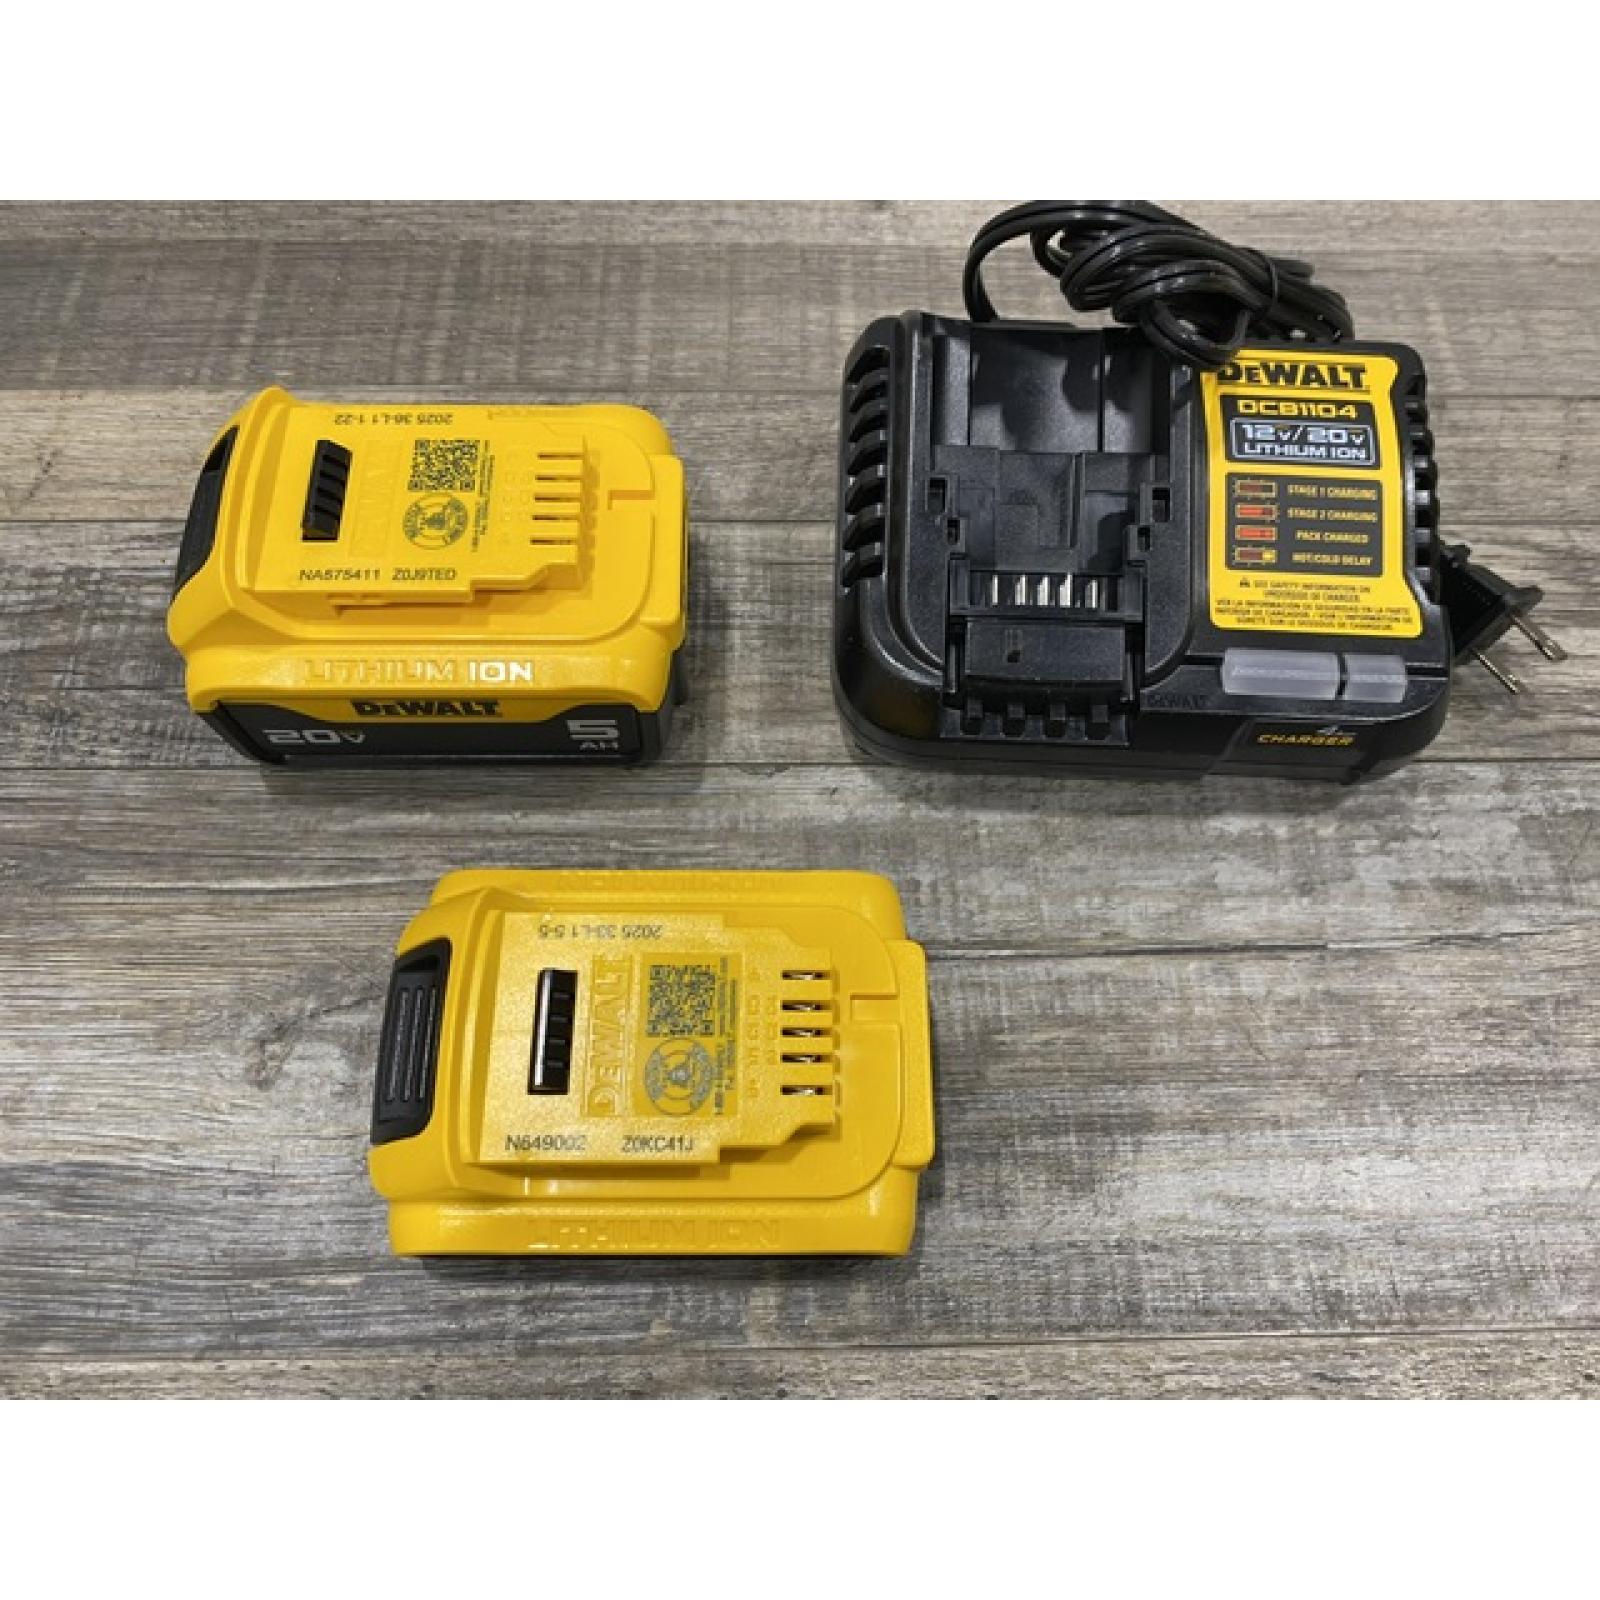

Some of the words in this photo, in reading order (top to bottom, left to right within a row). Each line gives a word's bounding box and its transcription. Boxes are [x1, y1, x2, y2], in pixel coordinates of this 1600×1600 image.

[1237, 399, 1358, 419] DCB1104
[1244, 442, 1327, 458] LITHIUM
[1330, 446, 1367, 460] ION
[1287, 484, 1317, 497] STAGE
[1327, 486, 1378, 500] CHARGING
[1287, 507, 1317, 520] STAGE
[1327, 509, 1378, 523] CHARGING
[1296, 529, 1321, 541] PACK
[1323, 531, 1369, 544] CHARGED
[305, 659, 458, 682] LITHIUM
[468, 659, 535, 682] ION
[567, 719, 620, 741] 5
[1257, 733, 1354, 747] CHARGER
